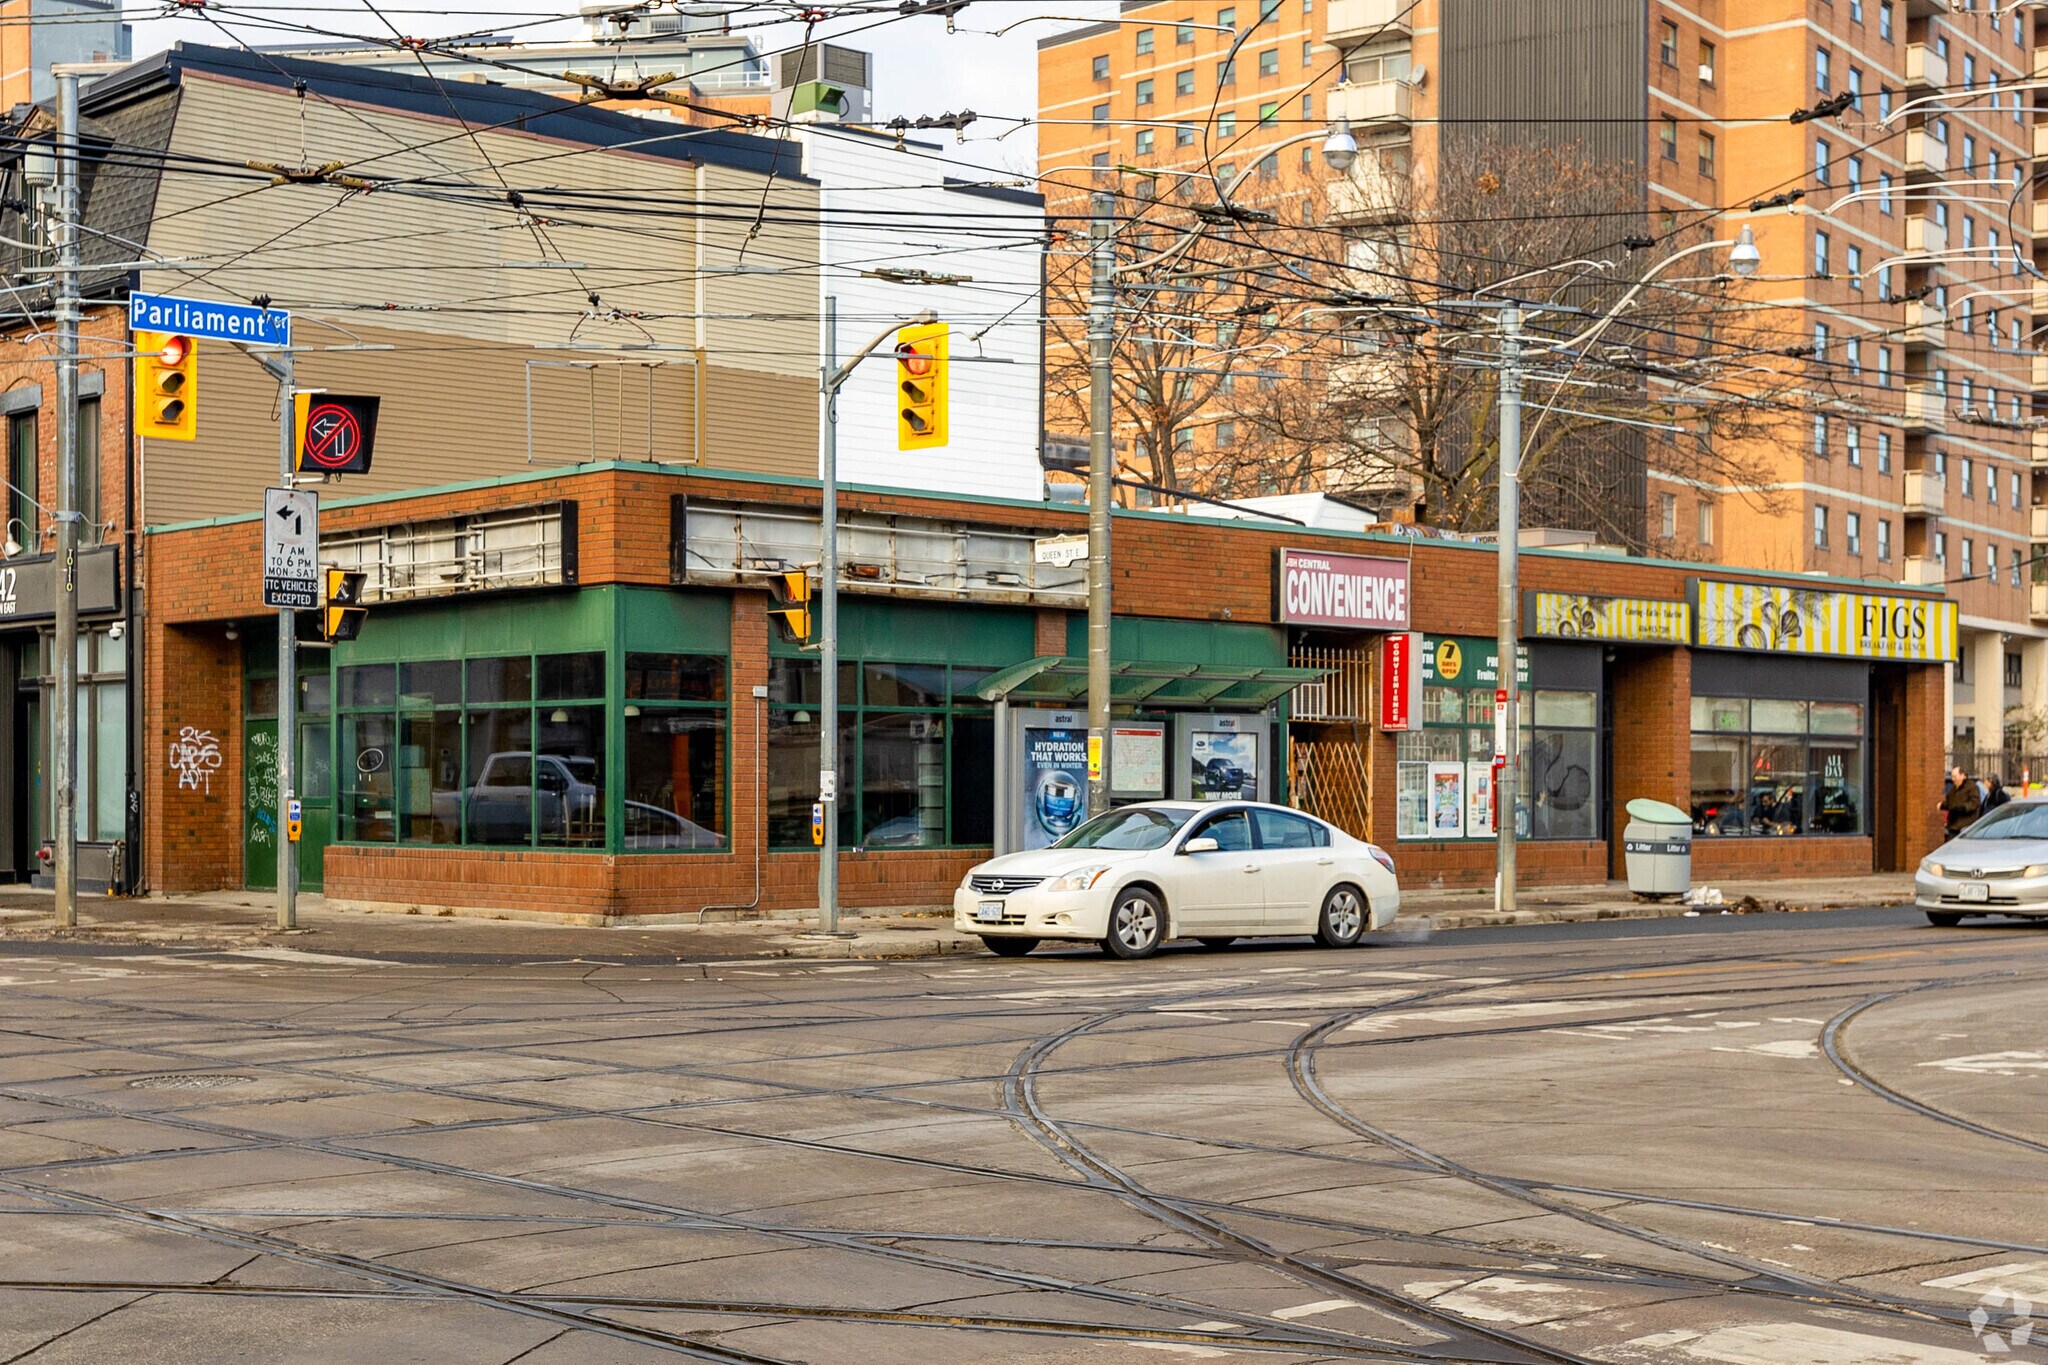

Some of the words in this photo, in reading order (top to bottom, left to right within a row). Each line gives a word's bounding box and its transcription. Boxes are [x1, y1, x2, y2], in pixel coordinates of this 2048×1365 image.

[134, 298, 265, 337] Parliament
[1478, 536, 1498, 544] YORK
[278, 543, 285, 554] 7
[290, 547, 305, 555] AM
[1042, 551, 1062, 560] QUEEN
[1075, 548, 1080, 557] E
[271, 557, 283, 566] TO
[287, 556, 294, 567] 6
[298, 559, 312, 568] PM
[1298, 558, 1331, 571] CENTRAL
[268, 567, 289, 576] MON
[296, 569, 315, 578] SAT
[265, 579, 280, 590] TTC
[281, 581, 318, 593] VEHICLES
[271, 592, 311, 604] EXCEPTED
[1287, 569, 1406, 621] CONVENIENCE
[1862, 605, 1925, 639] FIGS
[1443, 644, 1456, 659] 7
[1860, 640, 1897, 651] BREAKFAST
[1904, 642, 1926, 652] LUNCH
[1055, 715, 1072, 723] astral
[1034, 742, 1084, 752] HYDRATION
[1031, 752, 1053, 762] THAT
[1827, 754, 1842, 768] ALL
[1825, 765, 1843, 778] DAY
[1205, 791, 1221, 800] WAY
[1222, 792, 1242, 800] MORE
[1635, 843, 1652, 851] Litter
[1667, 844, 1681, 852] Litter
